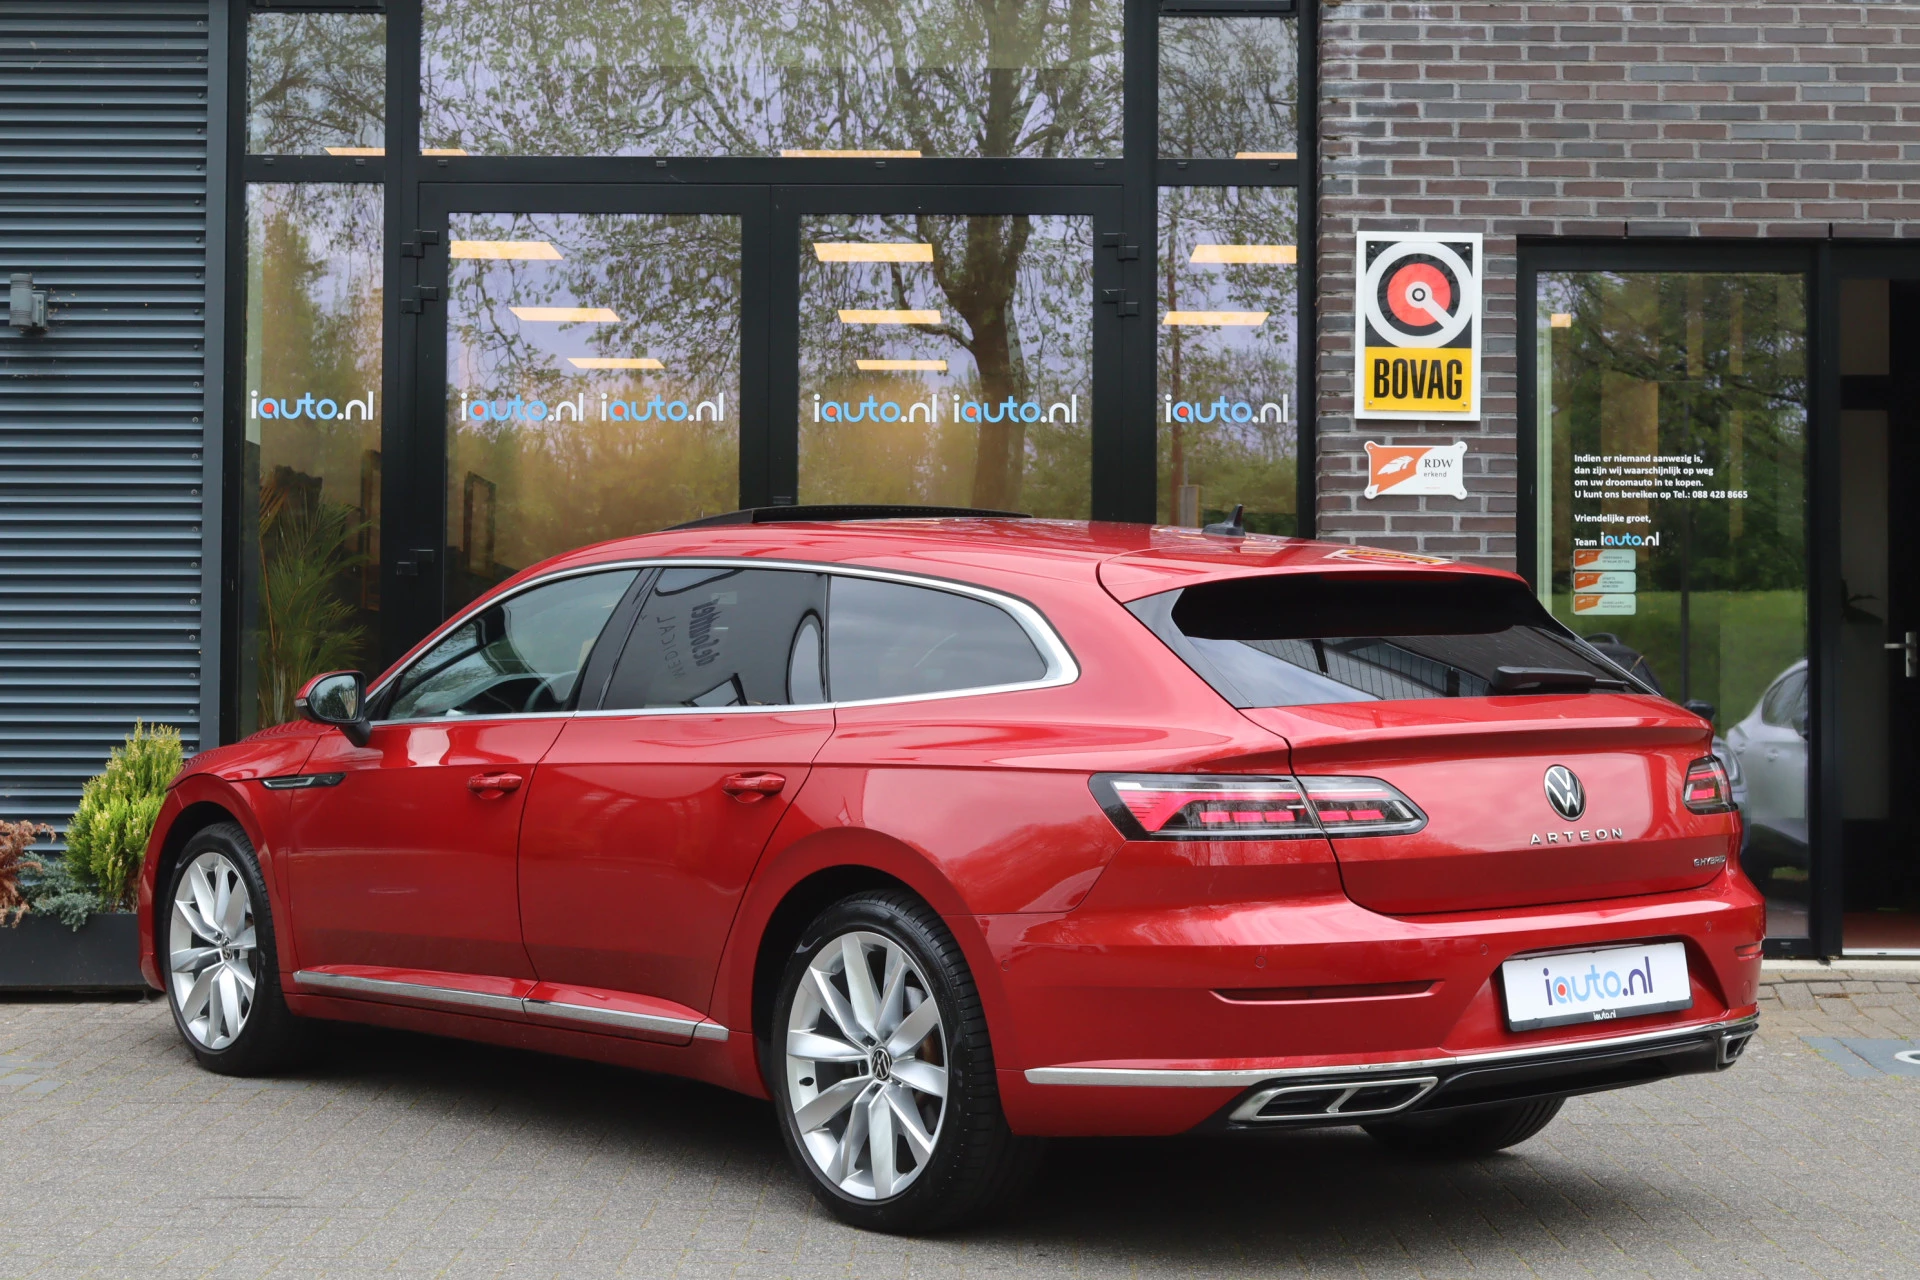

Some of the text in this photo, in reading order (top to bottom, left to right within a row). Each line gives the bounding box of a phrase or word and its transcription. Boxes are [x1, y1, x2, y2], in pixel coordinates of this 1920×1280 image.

[1374, 358, 1463, 400] BOVAG
[250, 390, 374, 421] iauto.nl
[461, 392, 724, 422] iauto.nl iauto.nl
[814, 393, 1077, 423] iauto.nl iauto.nl
[1165, 393, 1289, 424] iauto.nl
[1424, 458, 1454, 468] RDW
[1574, 454, 1601, 463] Indien
[1614, 454, 1651, 463] niemand
[1652, 454, 1692, 464] aanwezig
[1693, 454, 1703, 464] is,
[1574, 466, 1714, 476] dan zijn wij waarschijnlijk op weg
[1605, 478, 1652, 487] droomauto
[1654, 478, 1663, 487] in
[1664, 479, 1673, 487] te
[1675, 478, 1704, 488] kopen.
[1574, 491, 1582, 499] U
[1583, 490, 1603, 499] kunt
[1621, 490, 1658, 499] bereiken
[1660, 492, 1671, 500] op
[1673, 490, 1690, 499] Tel.:
[1692, 491, 1708, 499] 088
[1710, 491, 1726, 499] 428
[1727, 491, 1748, 499] 8665
[1574, 514, 1652, 524] Vriendelijke groet,
[1574, 532, 1660, 546] Team iauto.nl
[1530, 828, 1623, 845] ARTEON
[1543, 956, 1654, 1006] iauto.nl
